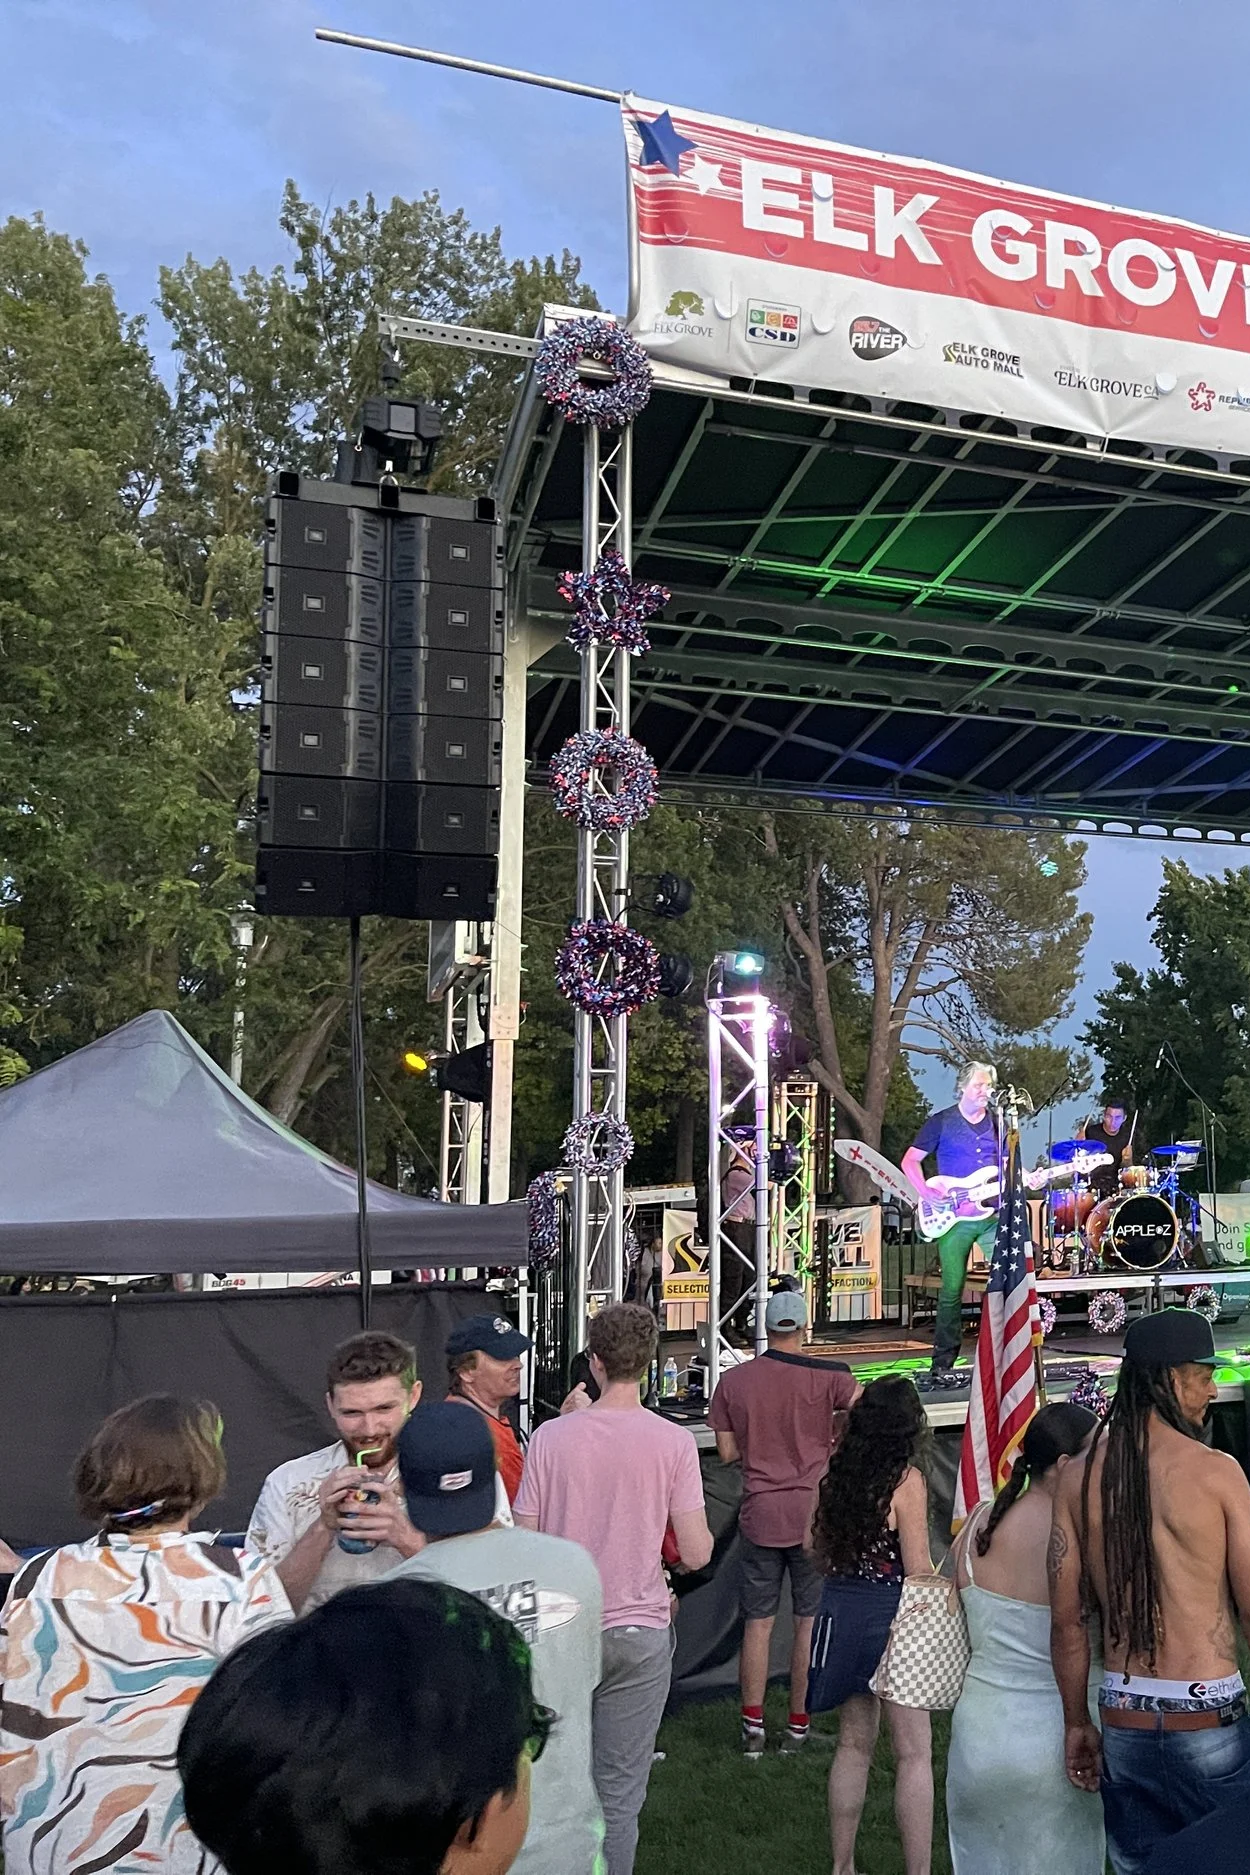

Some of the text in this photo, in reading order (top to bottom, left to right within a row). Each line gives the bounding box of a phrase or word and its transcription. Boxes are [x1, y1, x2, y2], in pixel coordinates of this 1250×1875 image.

[741, 158, 942, 266] ELK
[674, 322, 714, 338] GROVE
[748, 326, 797, 343] CSD
[851, 332, 904, 349] RIVER
[953, 342, 1021, 366] ELK GROVE
[955, 354, 1024, 379] AUTO MALL
[1054, 370, 1088, 391] ELK
[1089, 377, 1143, 399] GROVE
[1115, 1224, 1156, 1237] APPLE
[1216, 1222, 1240, 1235] Join
[1218, 1239, 1233, 1250] nd
[667, 1284, 710, 1294] SELECTIO
